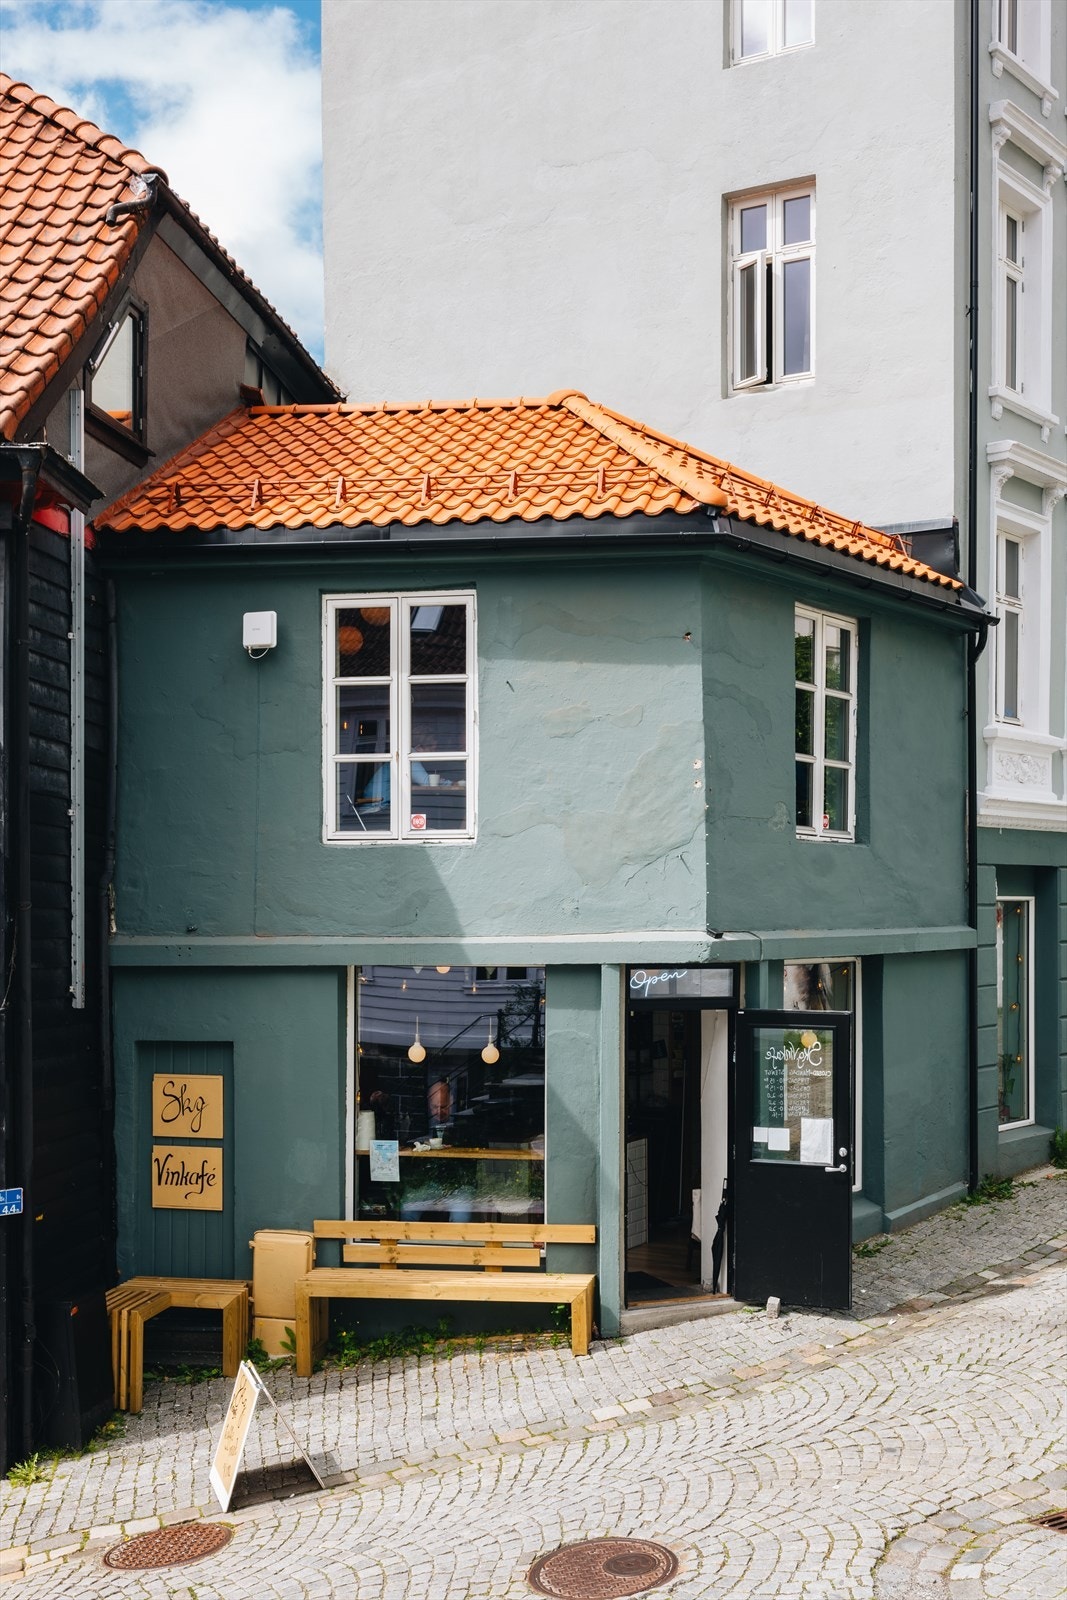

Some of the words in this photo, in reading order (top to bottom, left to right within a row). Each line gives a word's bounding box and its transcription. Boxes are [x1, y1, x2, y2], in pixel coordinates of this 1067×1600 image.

[630, 970, 687, 997] Open
[161, 1081, 208, 1133] Skg
[154, 1153, 216, 1199] Vinkafé
